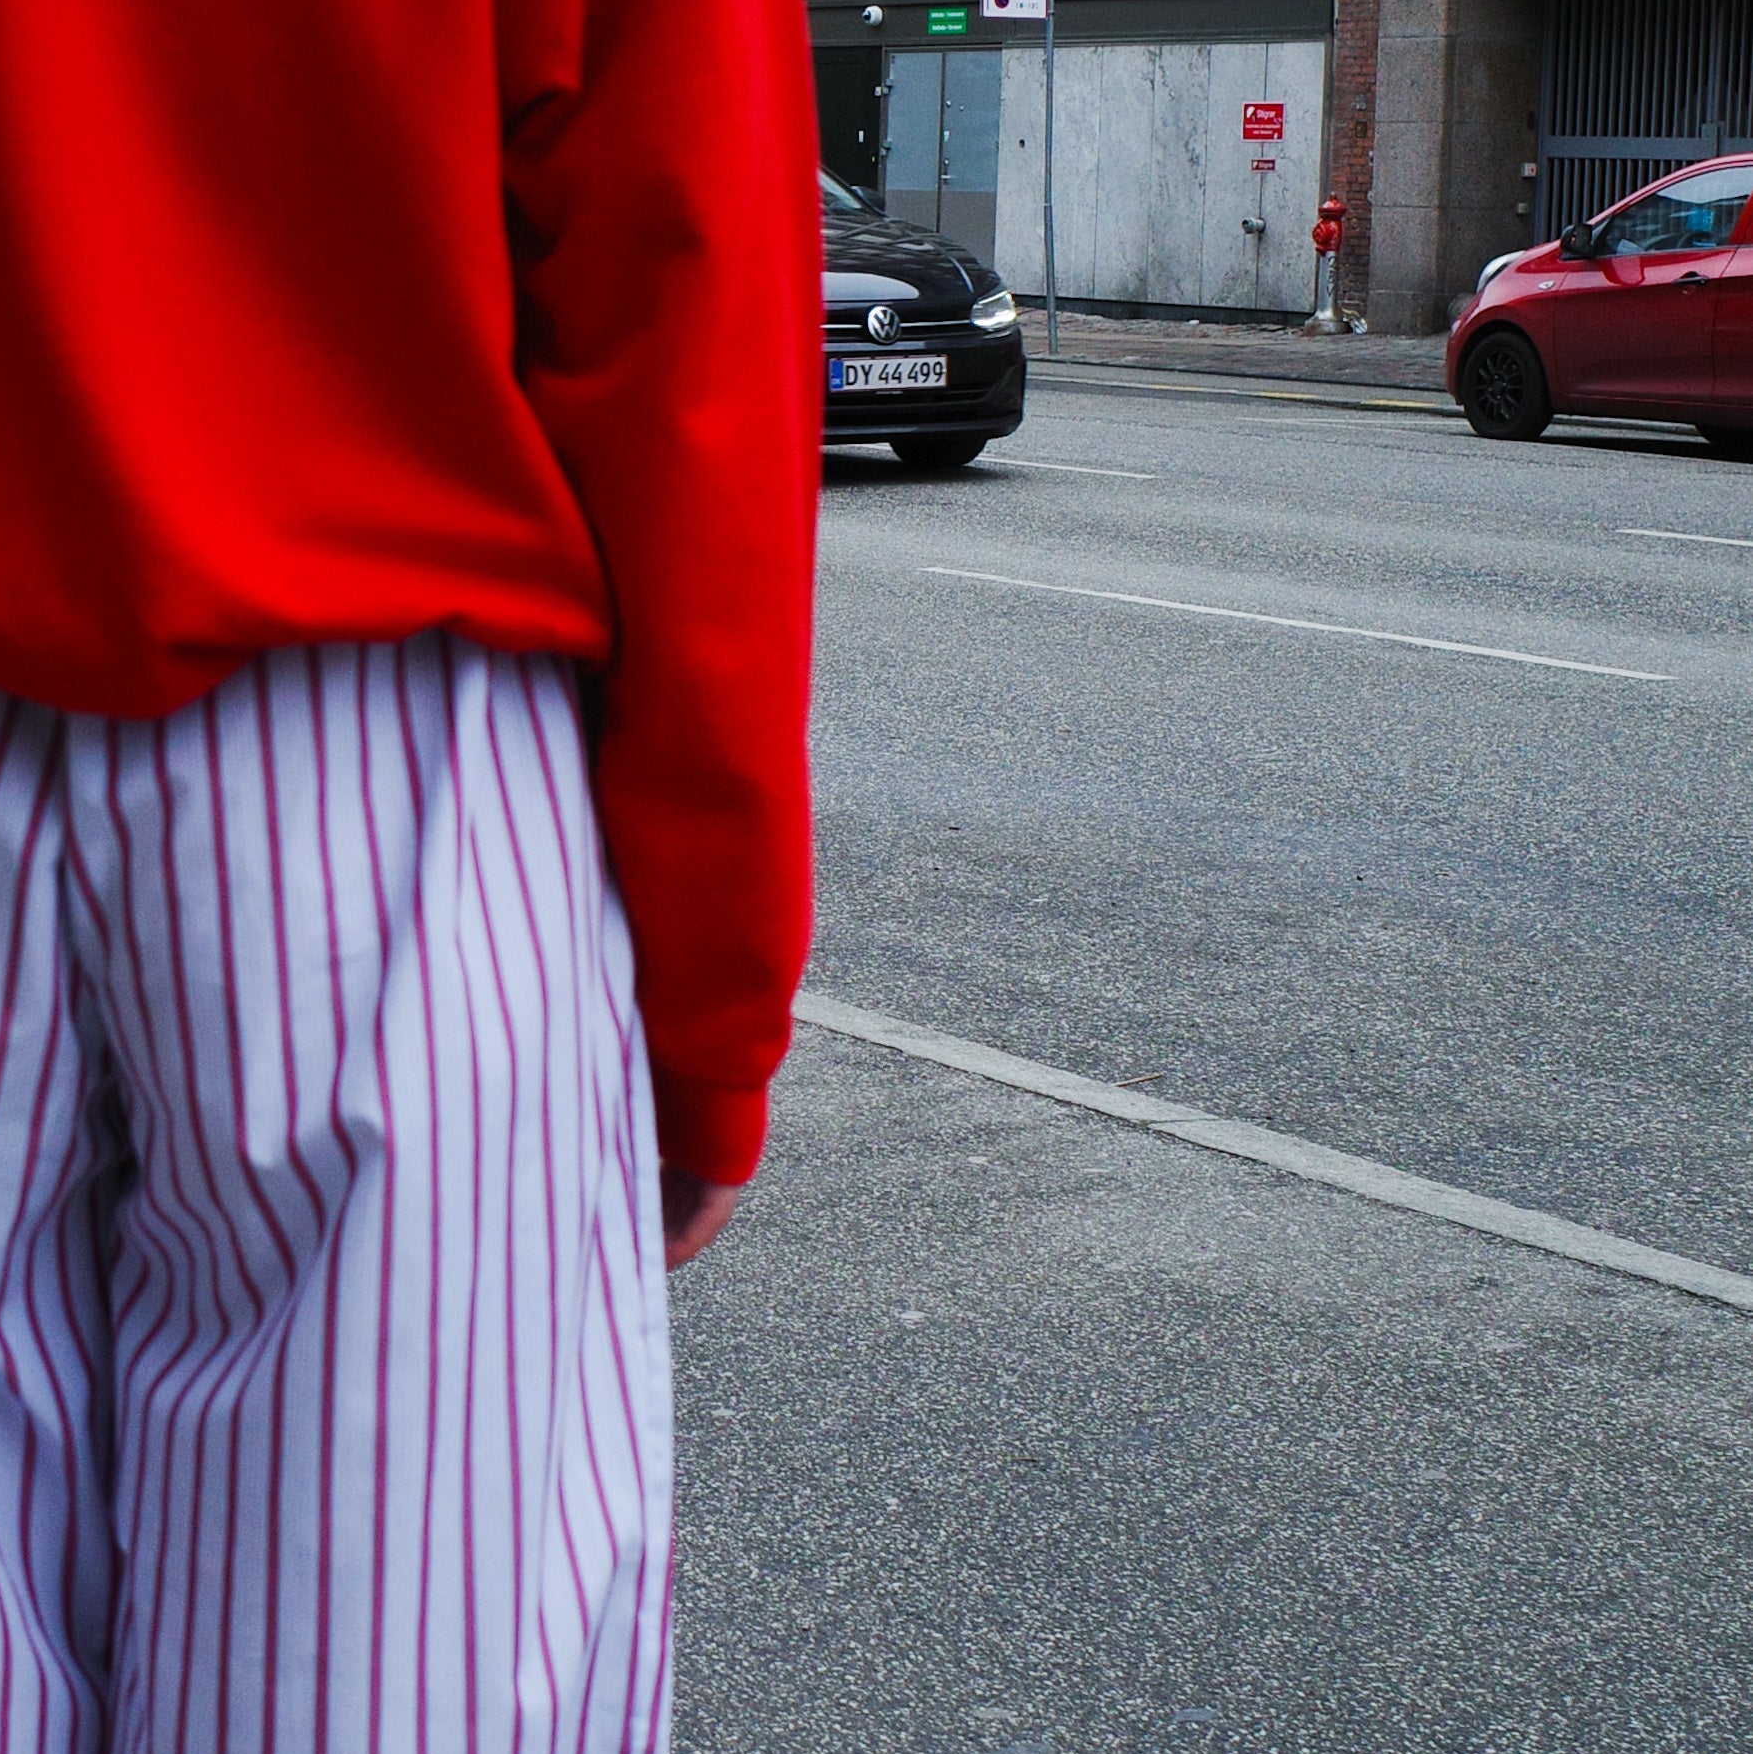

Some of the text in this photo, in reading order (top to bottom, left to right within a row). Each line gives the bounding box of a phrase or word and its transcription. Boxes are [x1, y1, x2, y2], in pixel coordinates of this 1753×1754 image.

[845, 361, 944, 386] DY 44 499
